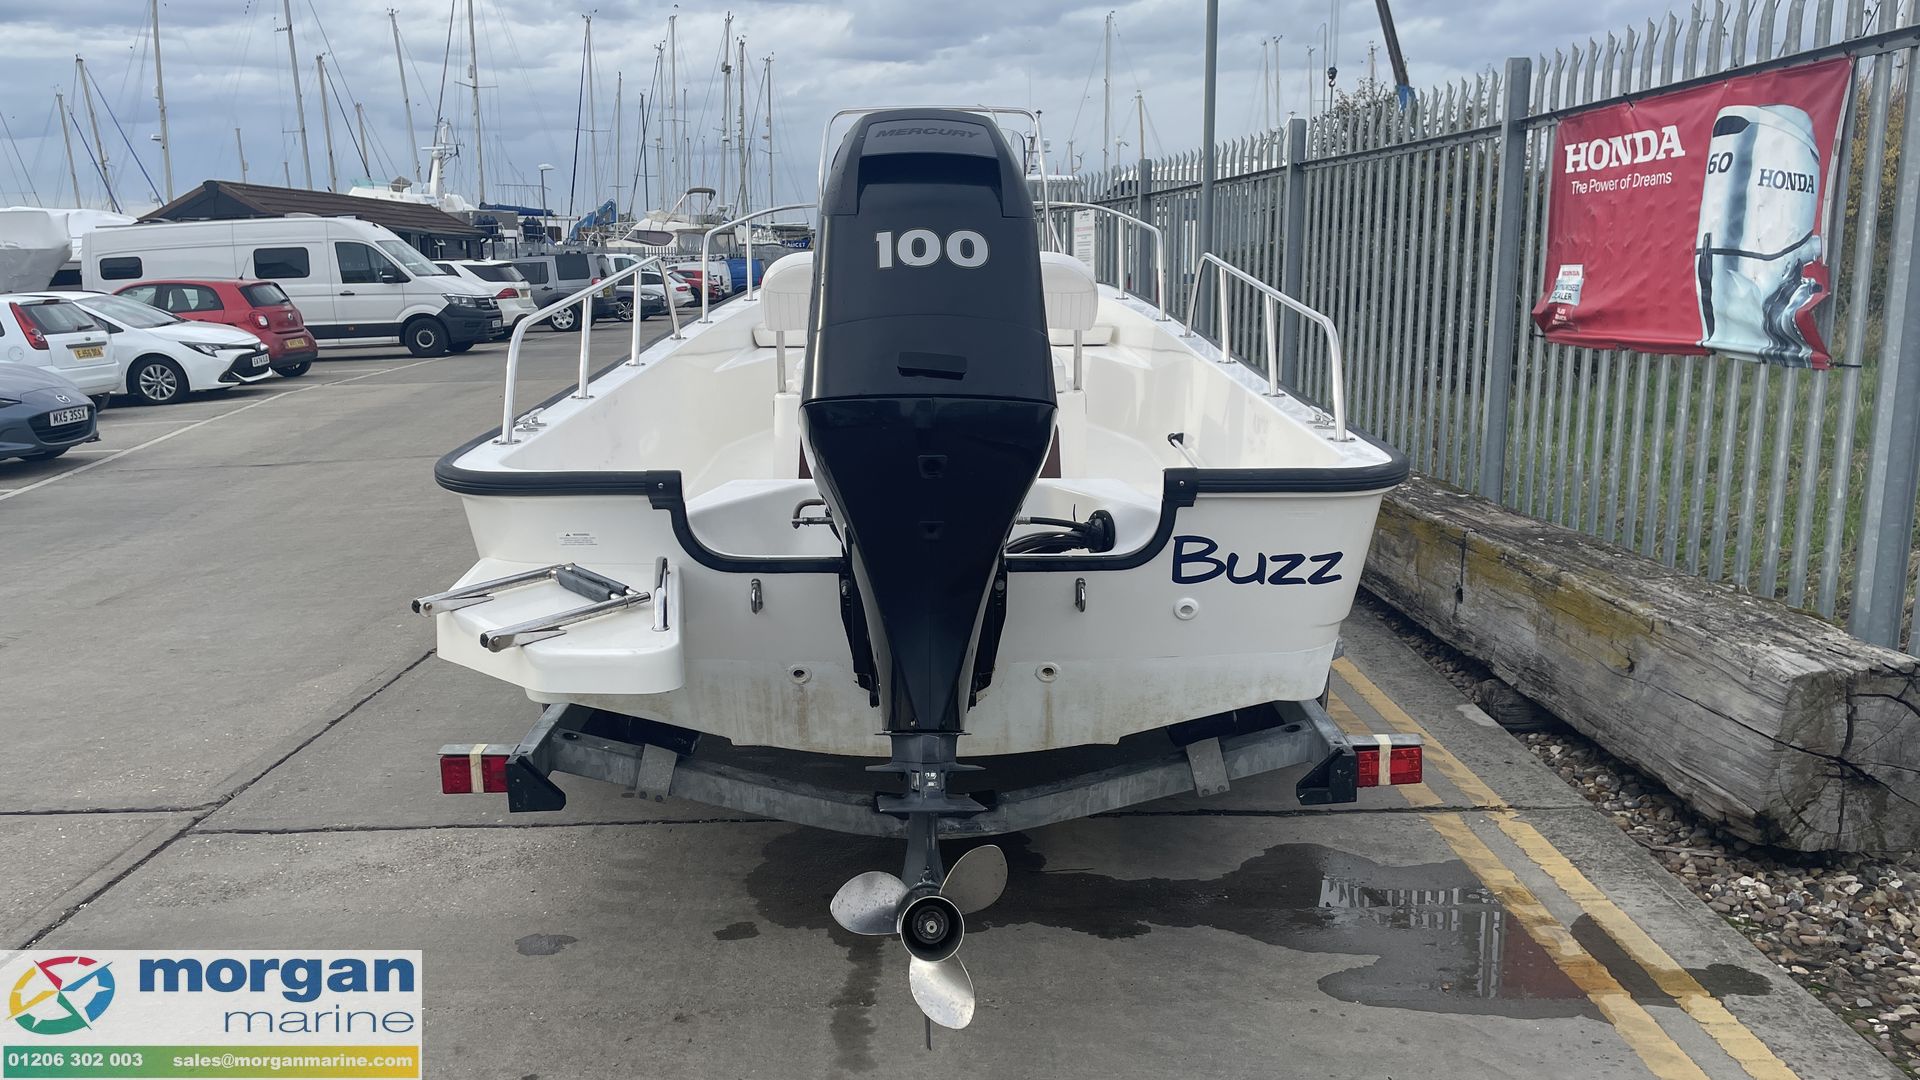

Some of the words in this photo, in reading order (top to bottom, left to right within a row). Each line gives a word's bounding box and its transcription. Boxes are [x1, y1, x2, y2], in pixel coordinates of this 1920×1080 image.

[875, 127, 981, 139] MERCURY
[1564, 125, 1686, 173] HONDA
[1707, 152, 1734, 175] 60
[1571, 179, 1588, 195] The
[1588, 176, 1619, 194] Power
[1620, 174, 1632, 190] of
[1632, 171, 1673, 189] Dreams
[1757, 168, 1815, 194] HONDA
[875, 229, 990, 269] 100
[1171, 535, 1344, 586] Buzz
